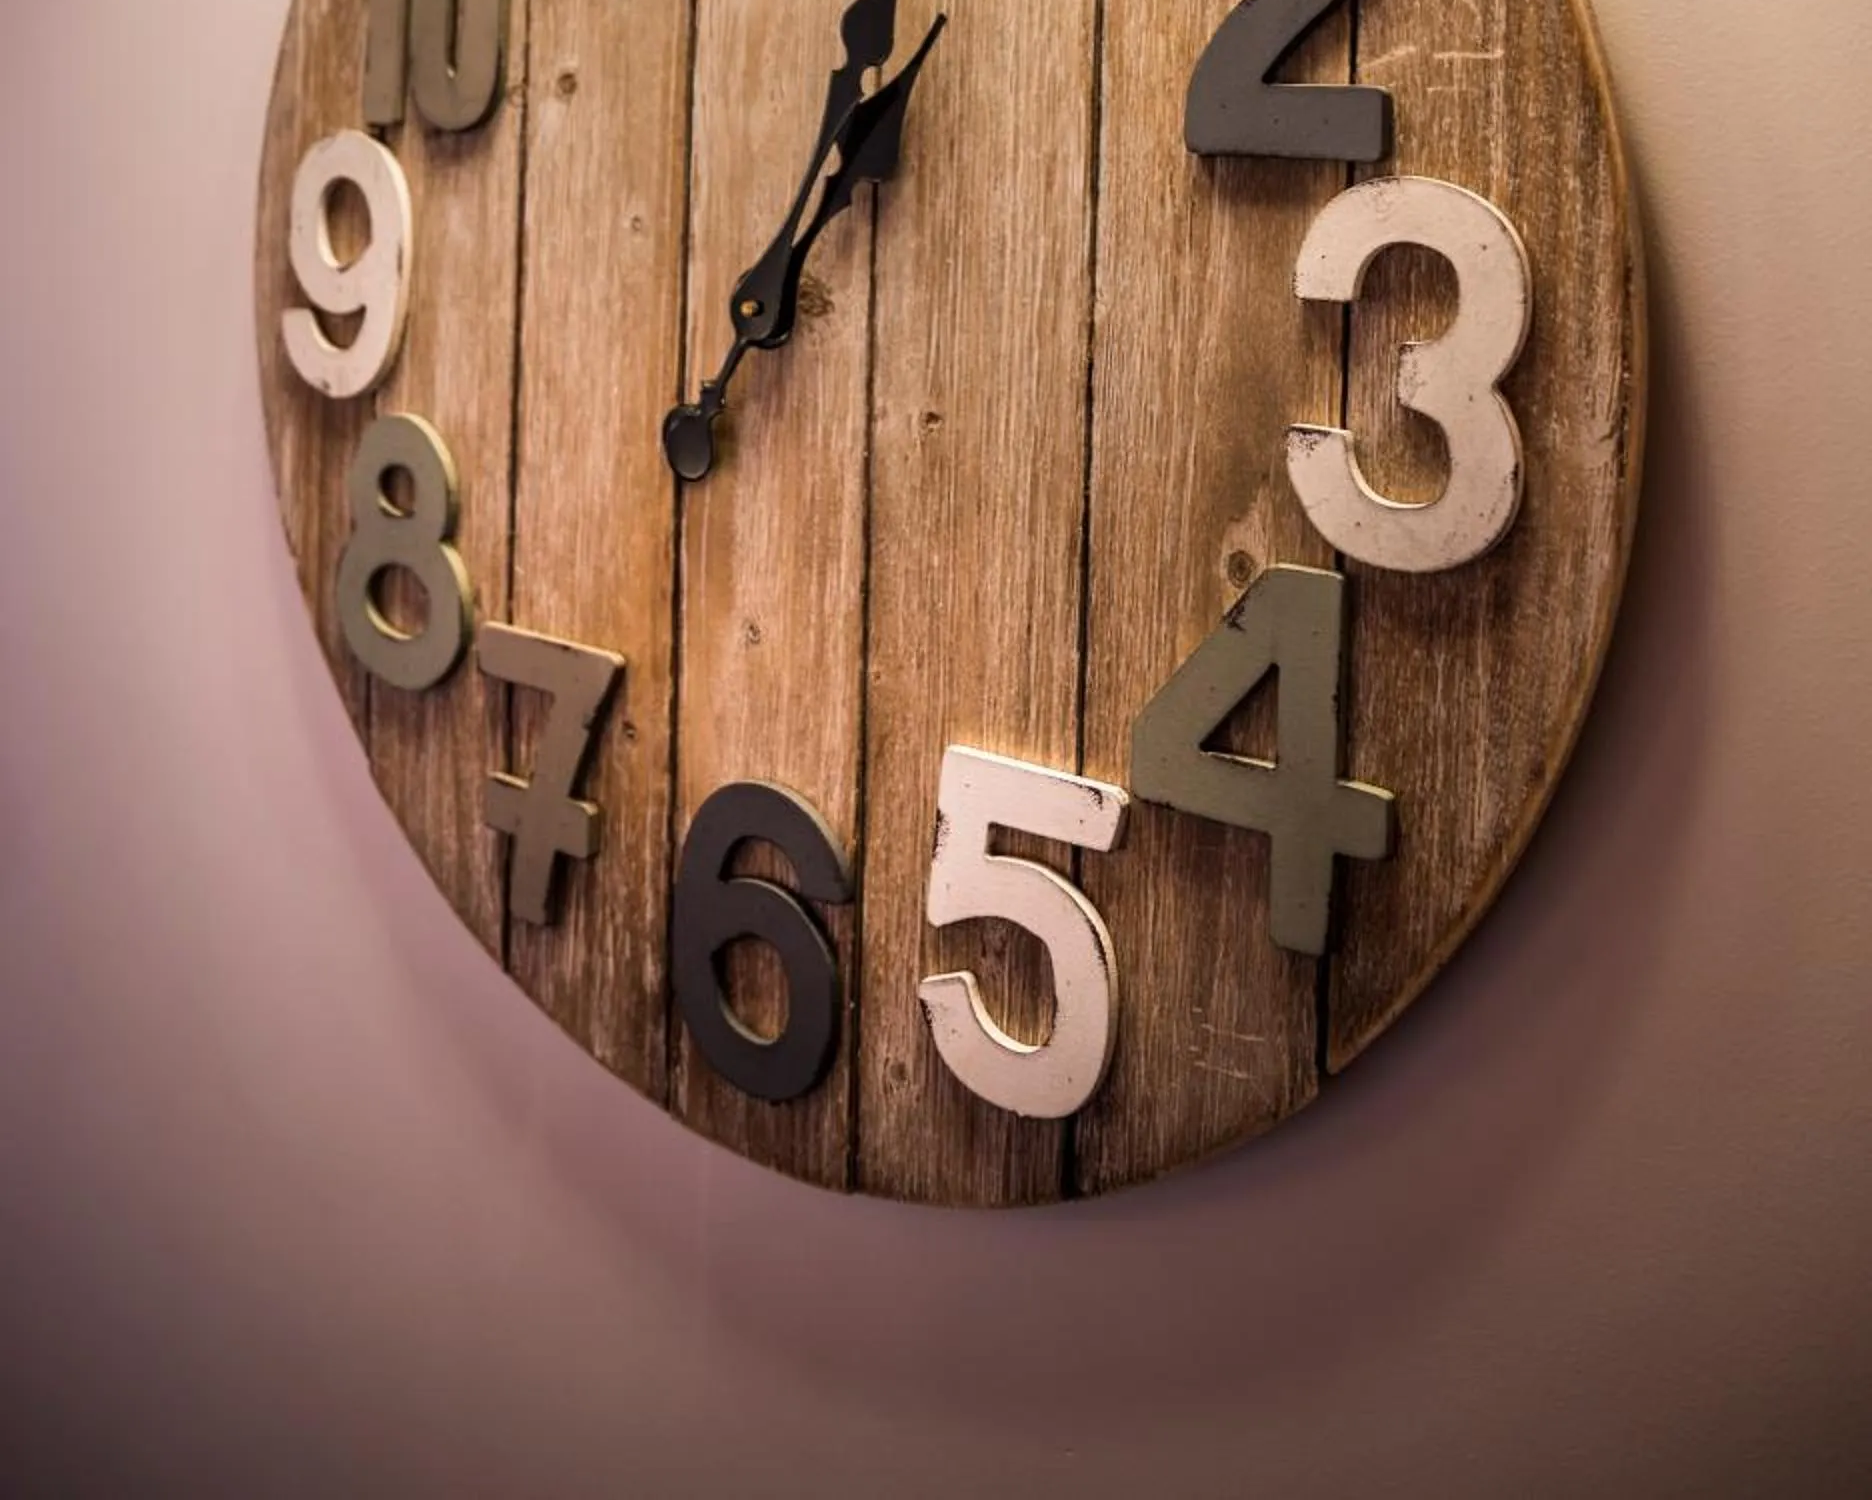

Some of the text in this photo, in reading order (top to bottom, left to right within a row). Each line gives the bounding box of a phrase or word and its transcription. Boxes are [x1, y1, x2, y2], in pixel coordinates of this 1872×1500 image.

[281, 132, 412, 399] 9
[1287, 177, 1531, 574] 3
[336, 412, 469, 690] 8
[477, 623, 627, 925] 7
[1132, 565, 1394, 956] 4
[675, 783, 852, 1101] 6
[921, 746, 1131, 1119] 5
